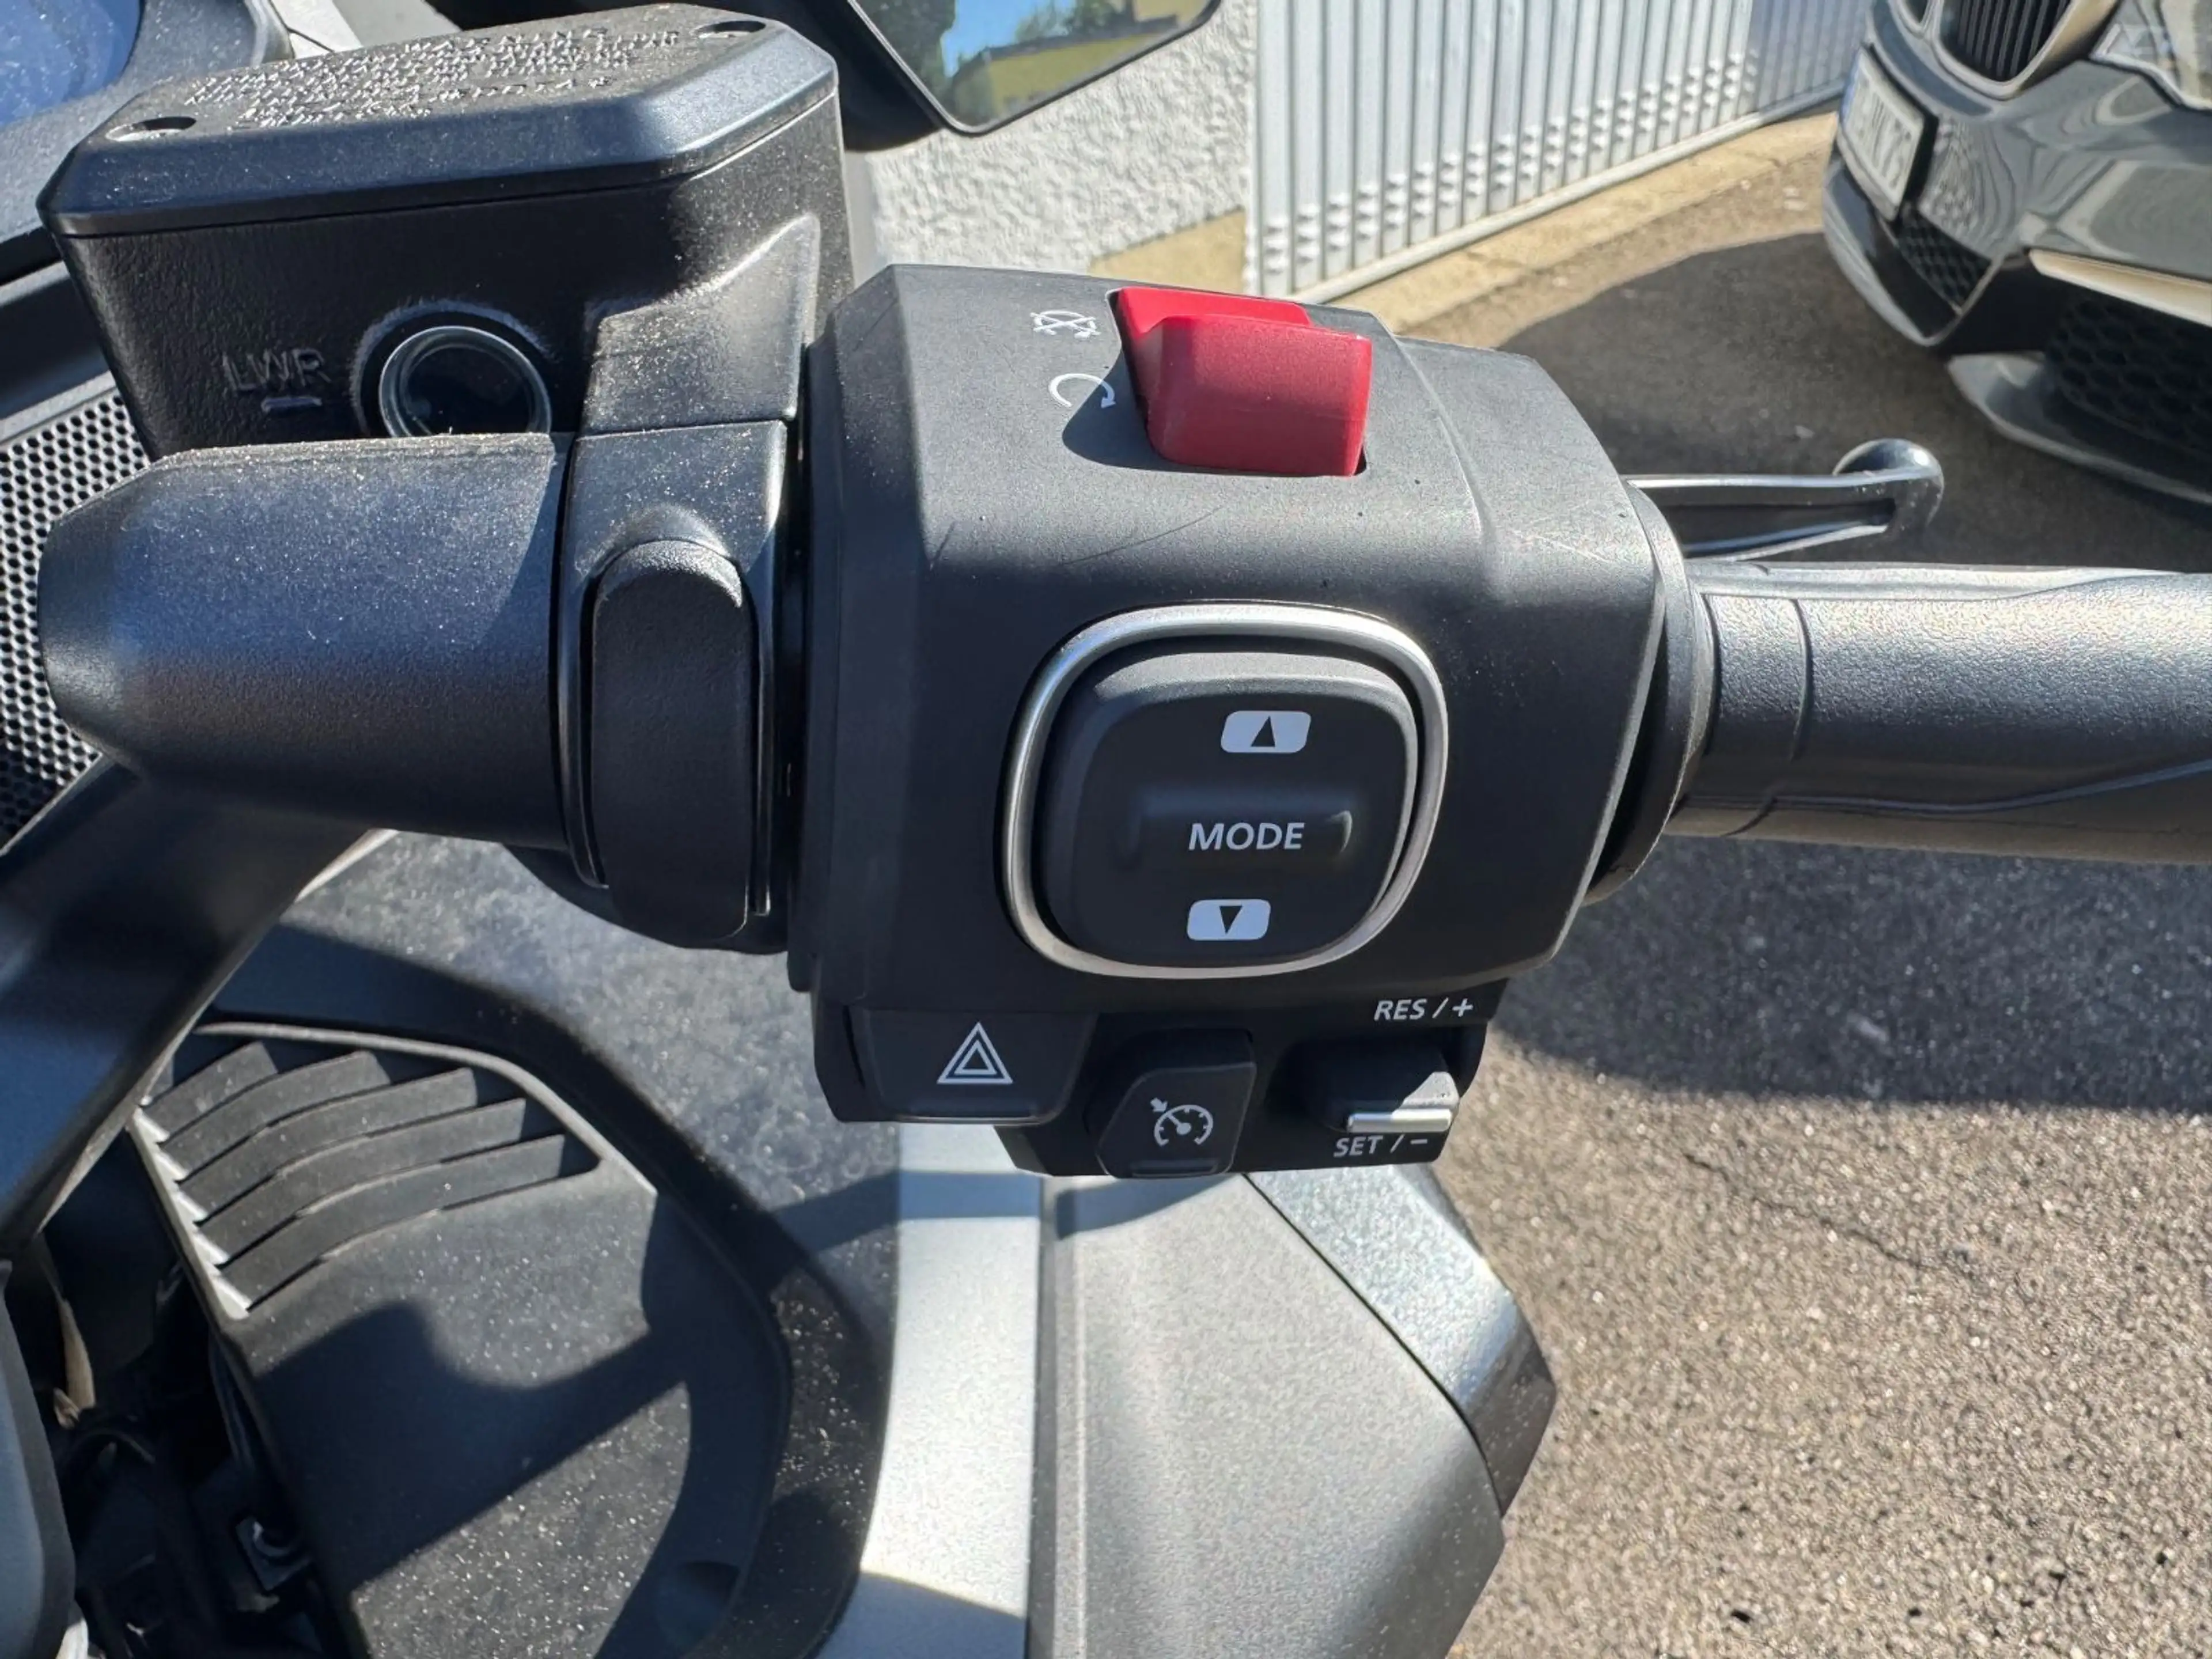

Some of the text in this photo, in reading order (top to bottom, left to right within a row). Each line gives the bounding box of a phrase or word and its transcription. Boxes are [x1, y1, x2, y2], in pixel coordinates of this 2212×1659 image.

[221, 347, 332, 391] LWR
[1188, 822, 1305, 850] MODE
[1373, 998, 1428, 1021] RES
[1334, 1135, 1384, 1158] SET
